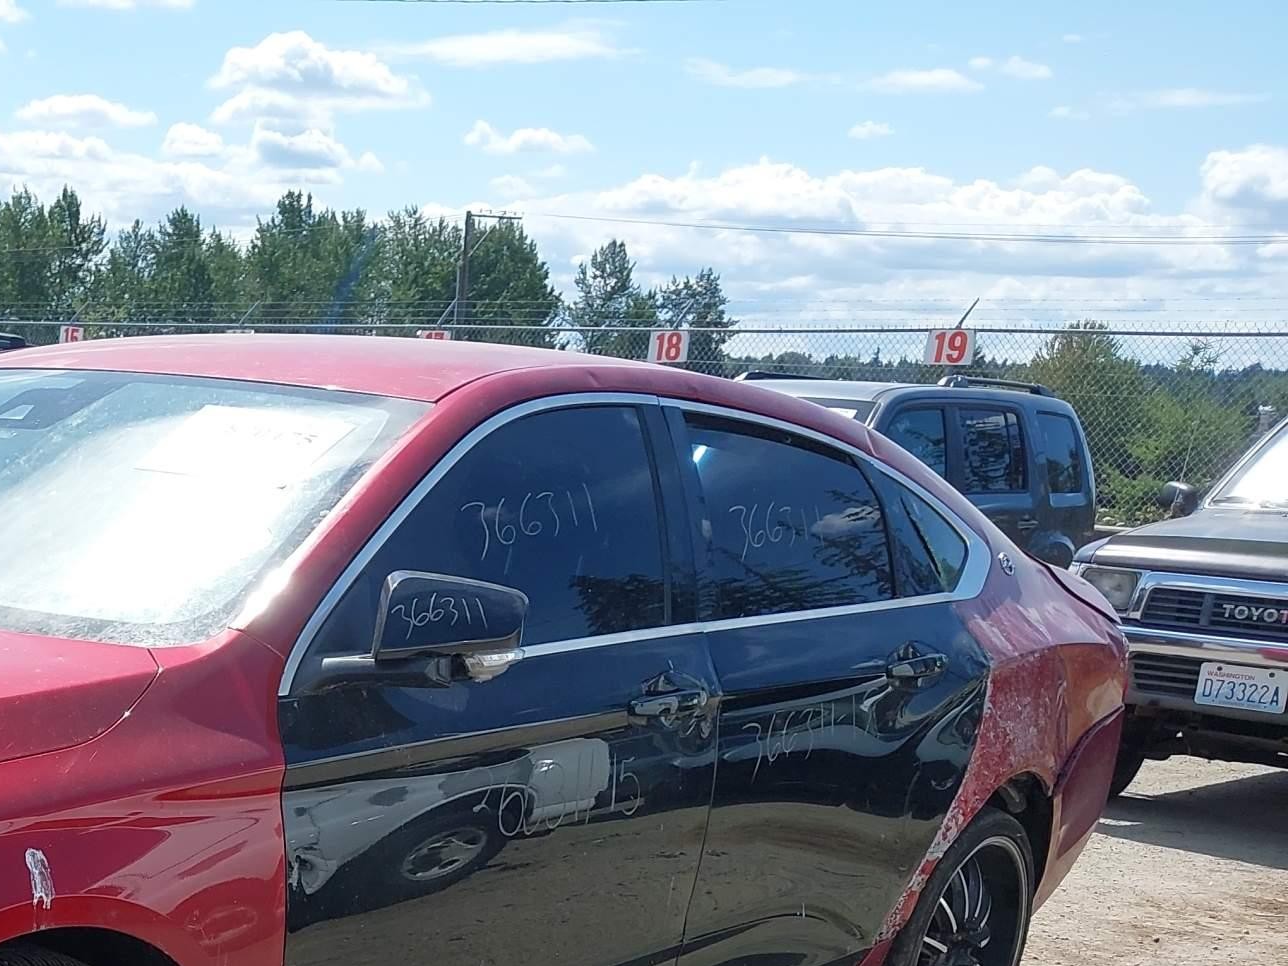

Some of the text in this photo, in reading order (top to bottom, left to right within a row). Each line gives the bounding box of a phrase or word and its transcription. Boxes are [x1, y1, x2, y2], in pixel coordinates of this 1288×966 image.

[655, 332, 682, 361] 18
[934, 331, 968, 364] 19
[461, 482, 598, 560] 366311
[728, 502, 826, 562] 366311
[391, 592, 488, 640] 366311
[1207, 670, 1256, 681] WASHINGTON
[1202, 678, 1280, 707] D73322A
